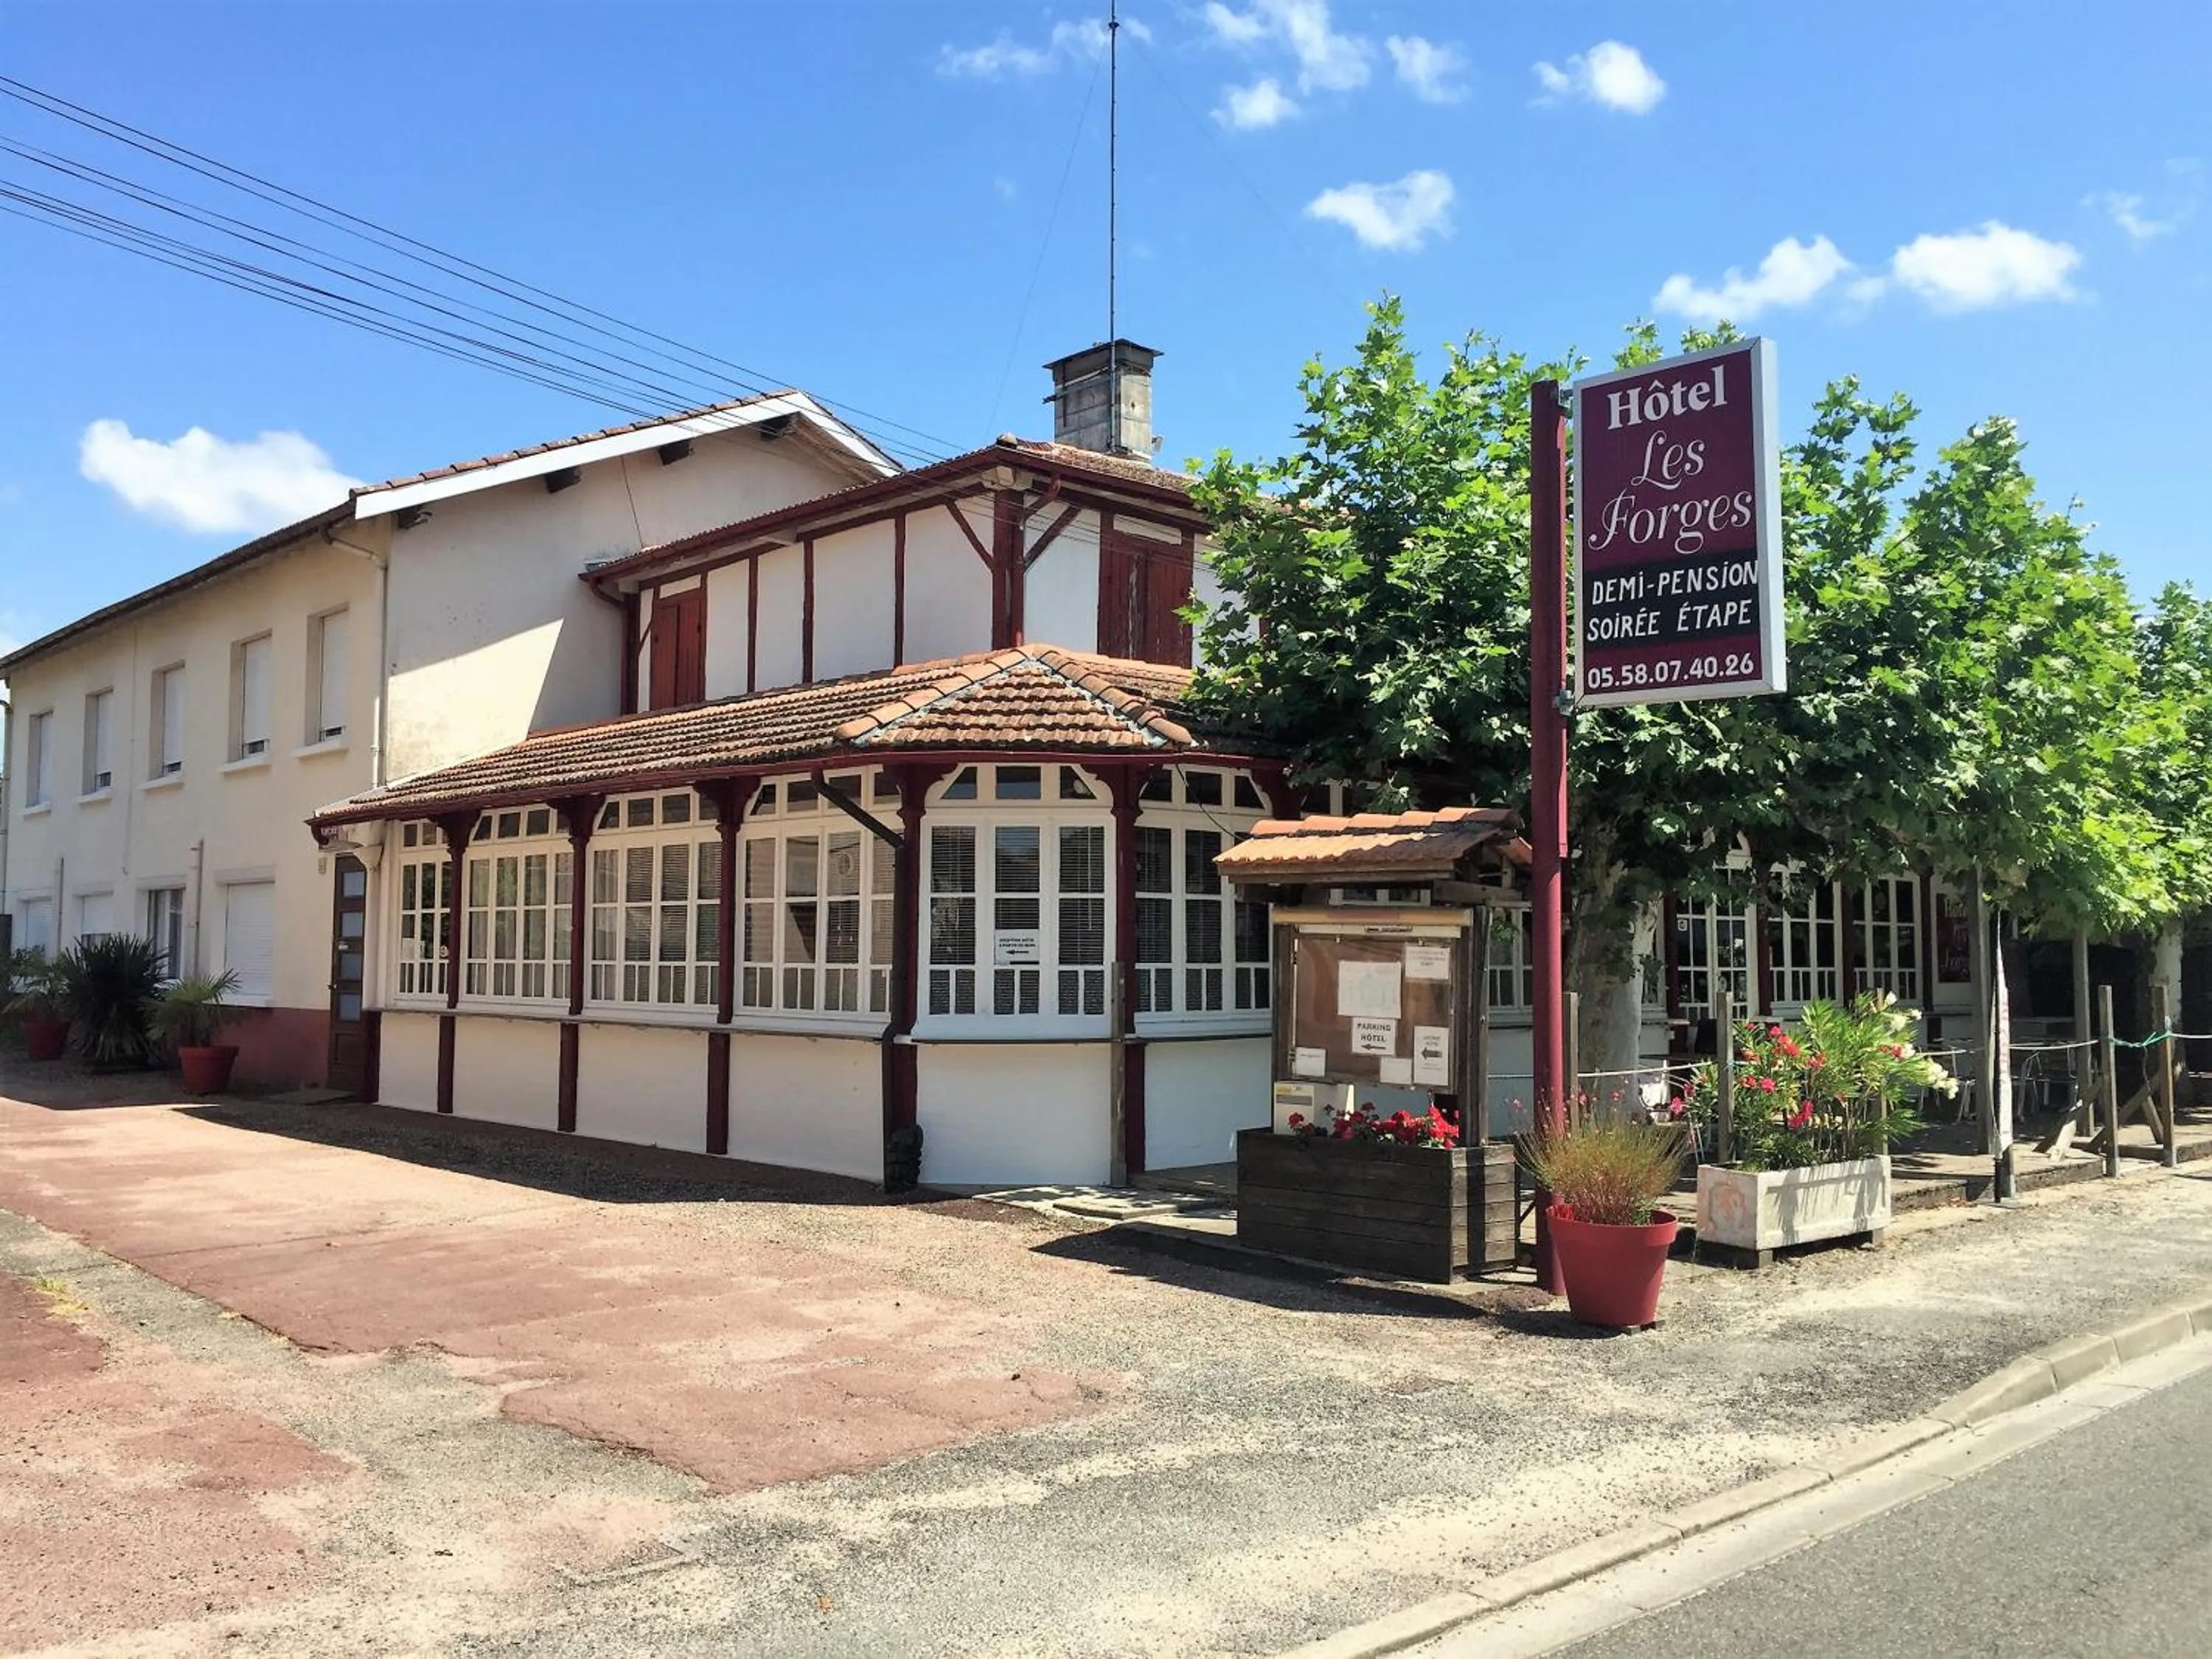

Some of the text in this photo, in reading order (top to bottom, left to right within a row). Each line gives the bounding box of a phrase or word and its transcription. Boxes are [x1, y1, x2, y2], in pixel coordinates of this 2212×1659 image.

[1607, 365, 1728, 431] Hôtel
[1630, 429, 1705, 490] Les
[1587, 488, 1753, 554] Forges
[1677, 598, 1753, 633] ÉTAPE
[1587, 652, 1754, 689] 05.58.07.40.26
[1357, 1023, 1391, 1032] PARKING
